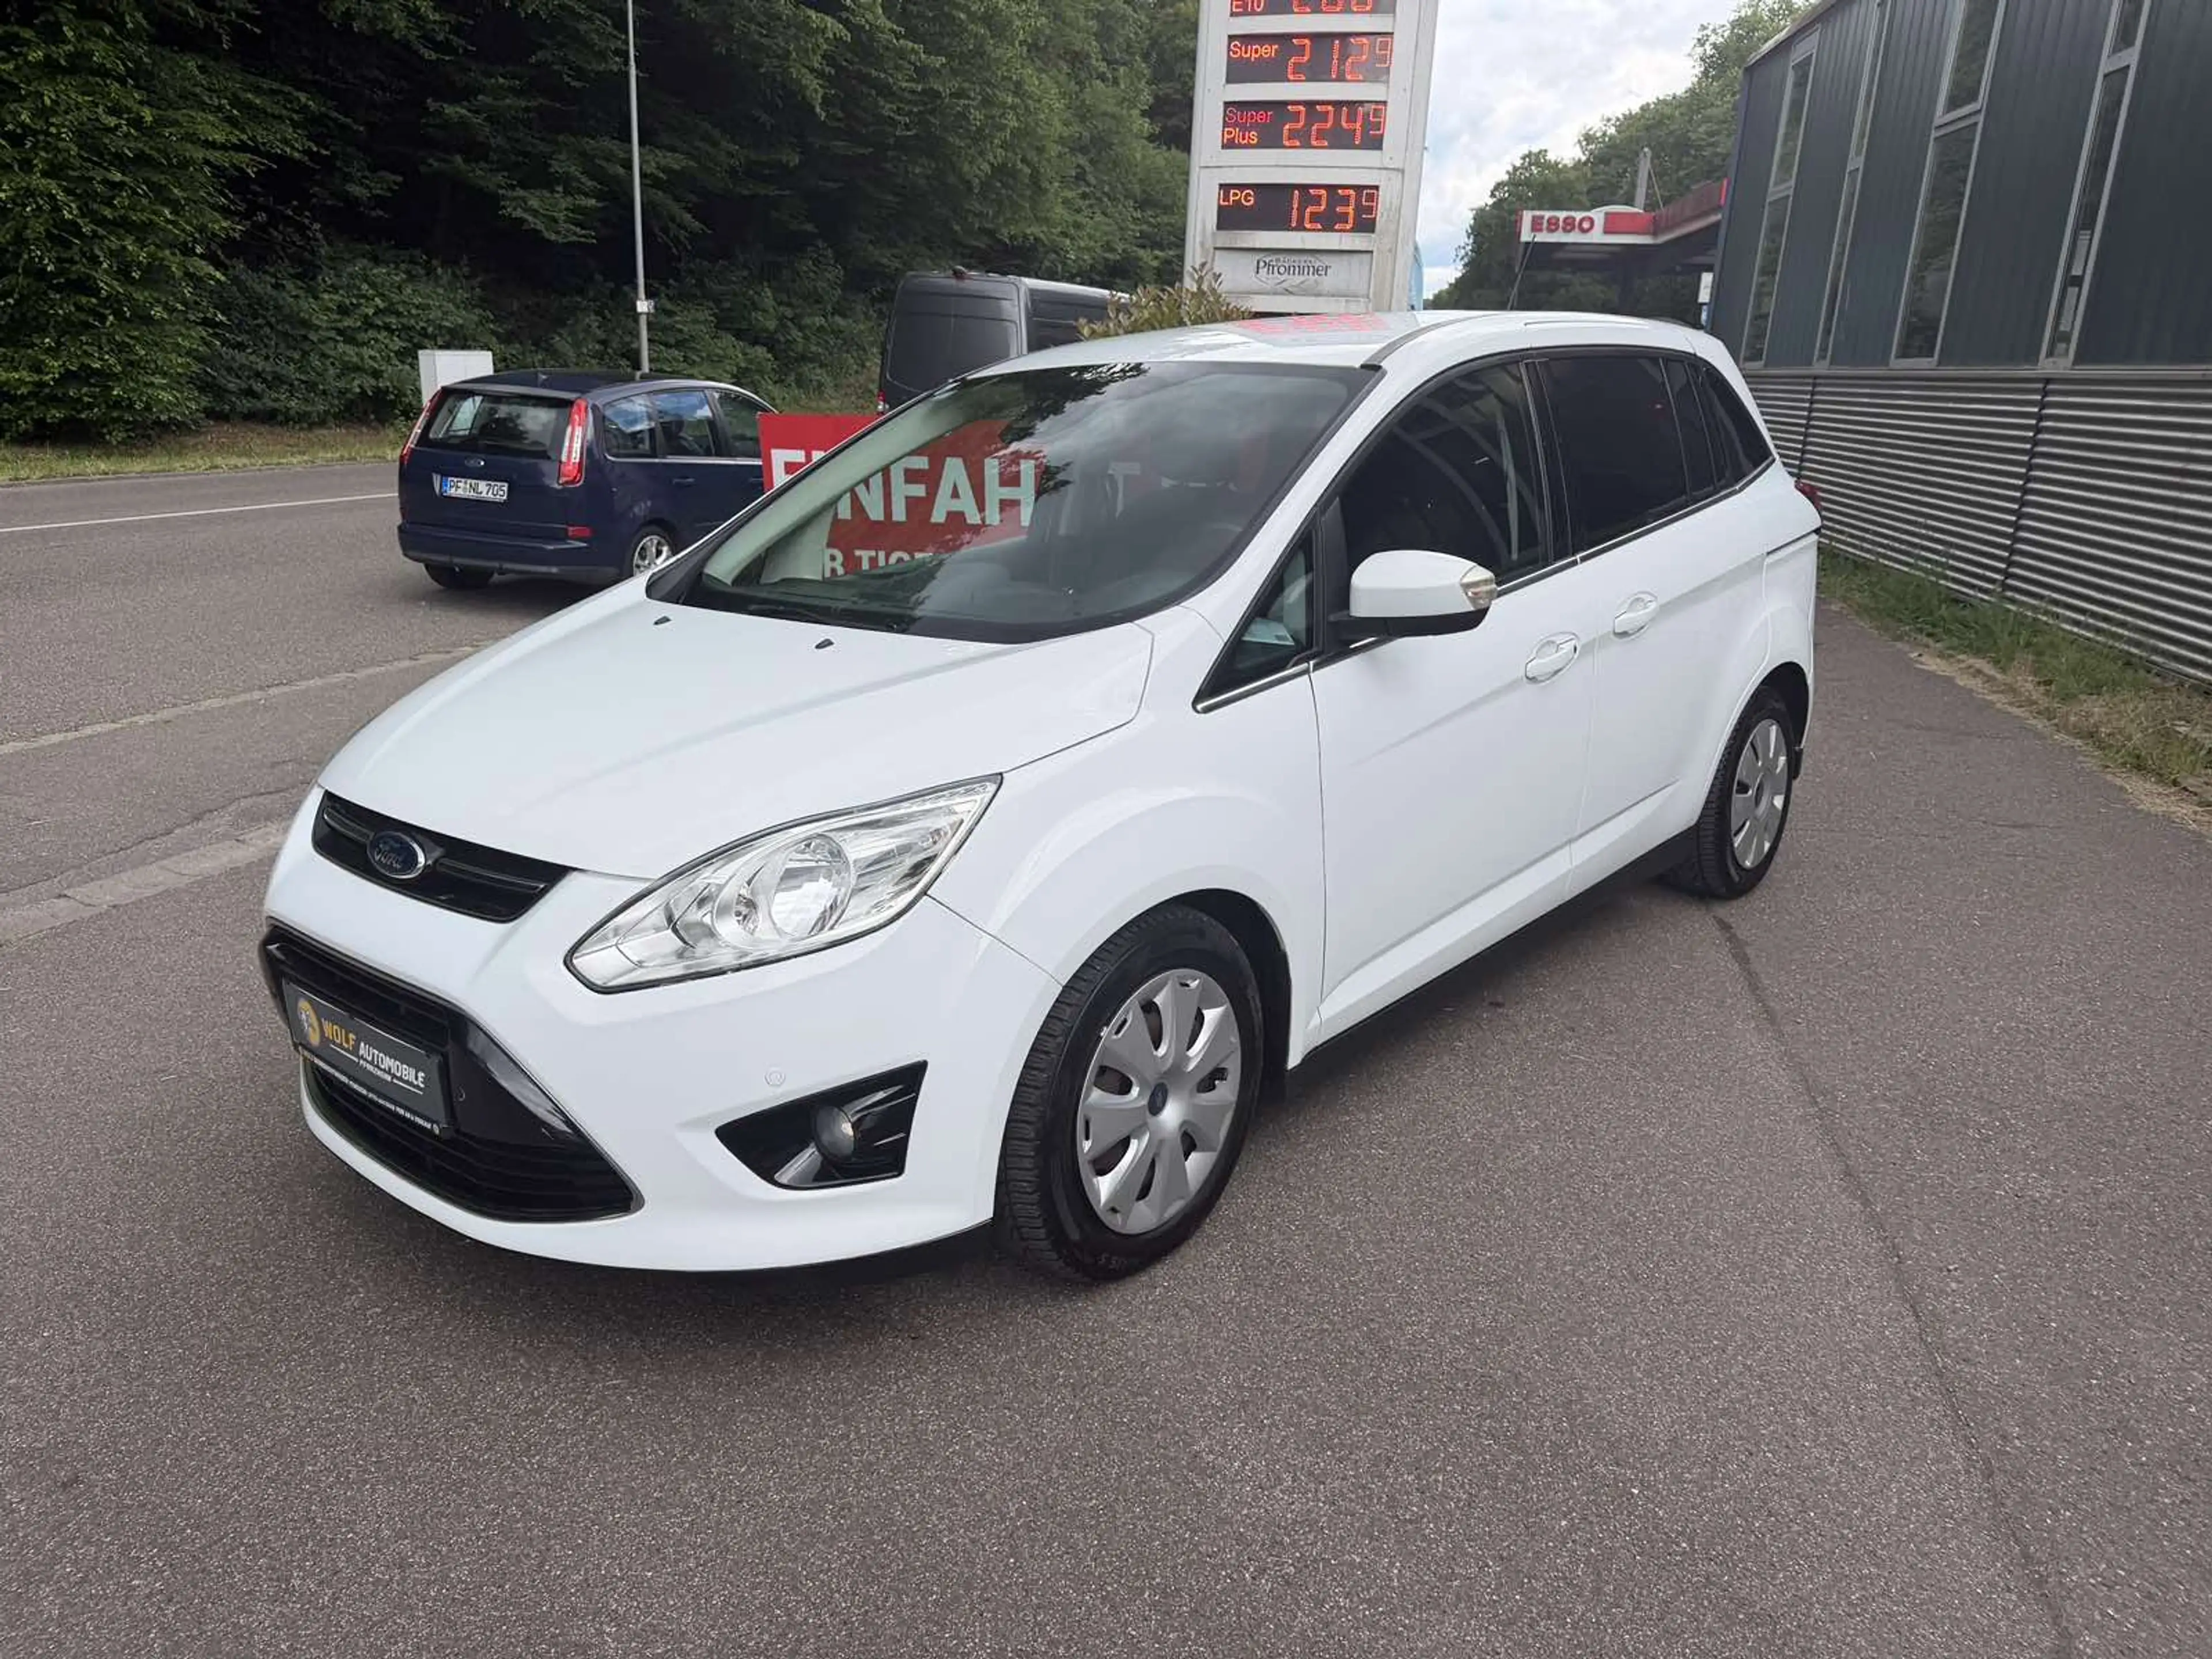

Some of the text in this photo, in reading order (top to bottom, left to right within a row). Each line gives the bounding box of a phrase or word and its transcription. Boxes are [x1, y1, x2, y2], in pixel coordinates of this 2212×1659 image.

[1229, 41, 1278, 61] Super
[1225, 108, 1273, 126] Super
[1223, 128, 1258, 145] Plus
[1219, 190, 1255, 206] LPG
[1255, 259, 1332, 277] Pfrommer
[449, 480, 506, 497] PF NL 705
[321, 1017, 356, 1051] WOLF
[359, 1041, 425, 1088] AUTOMOBILE
